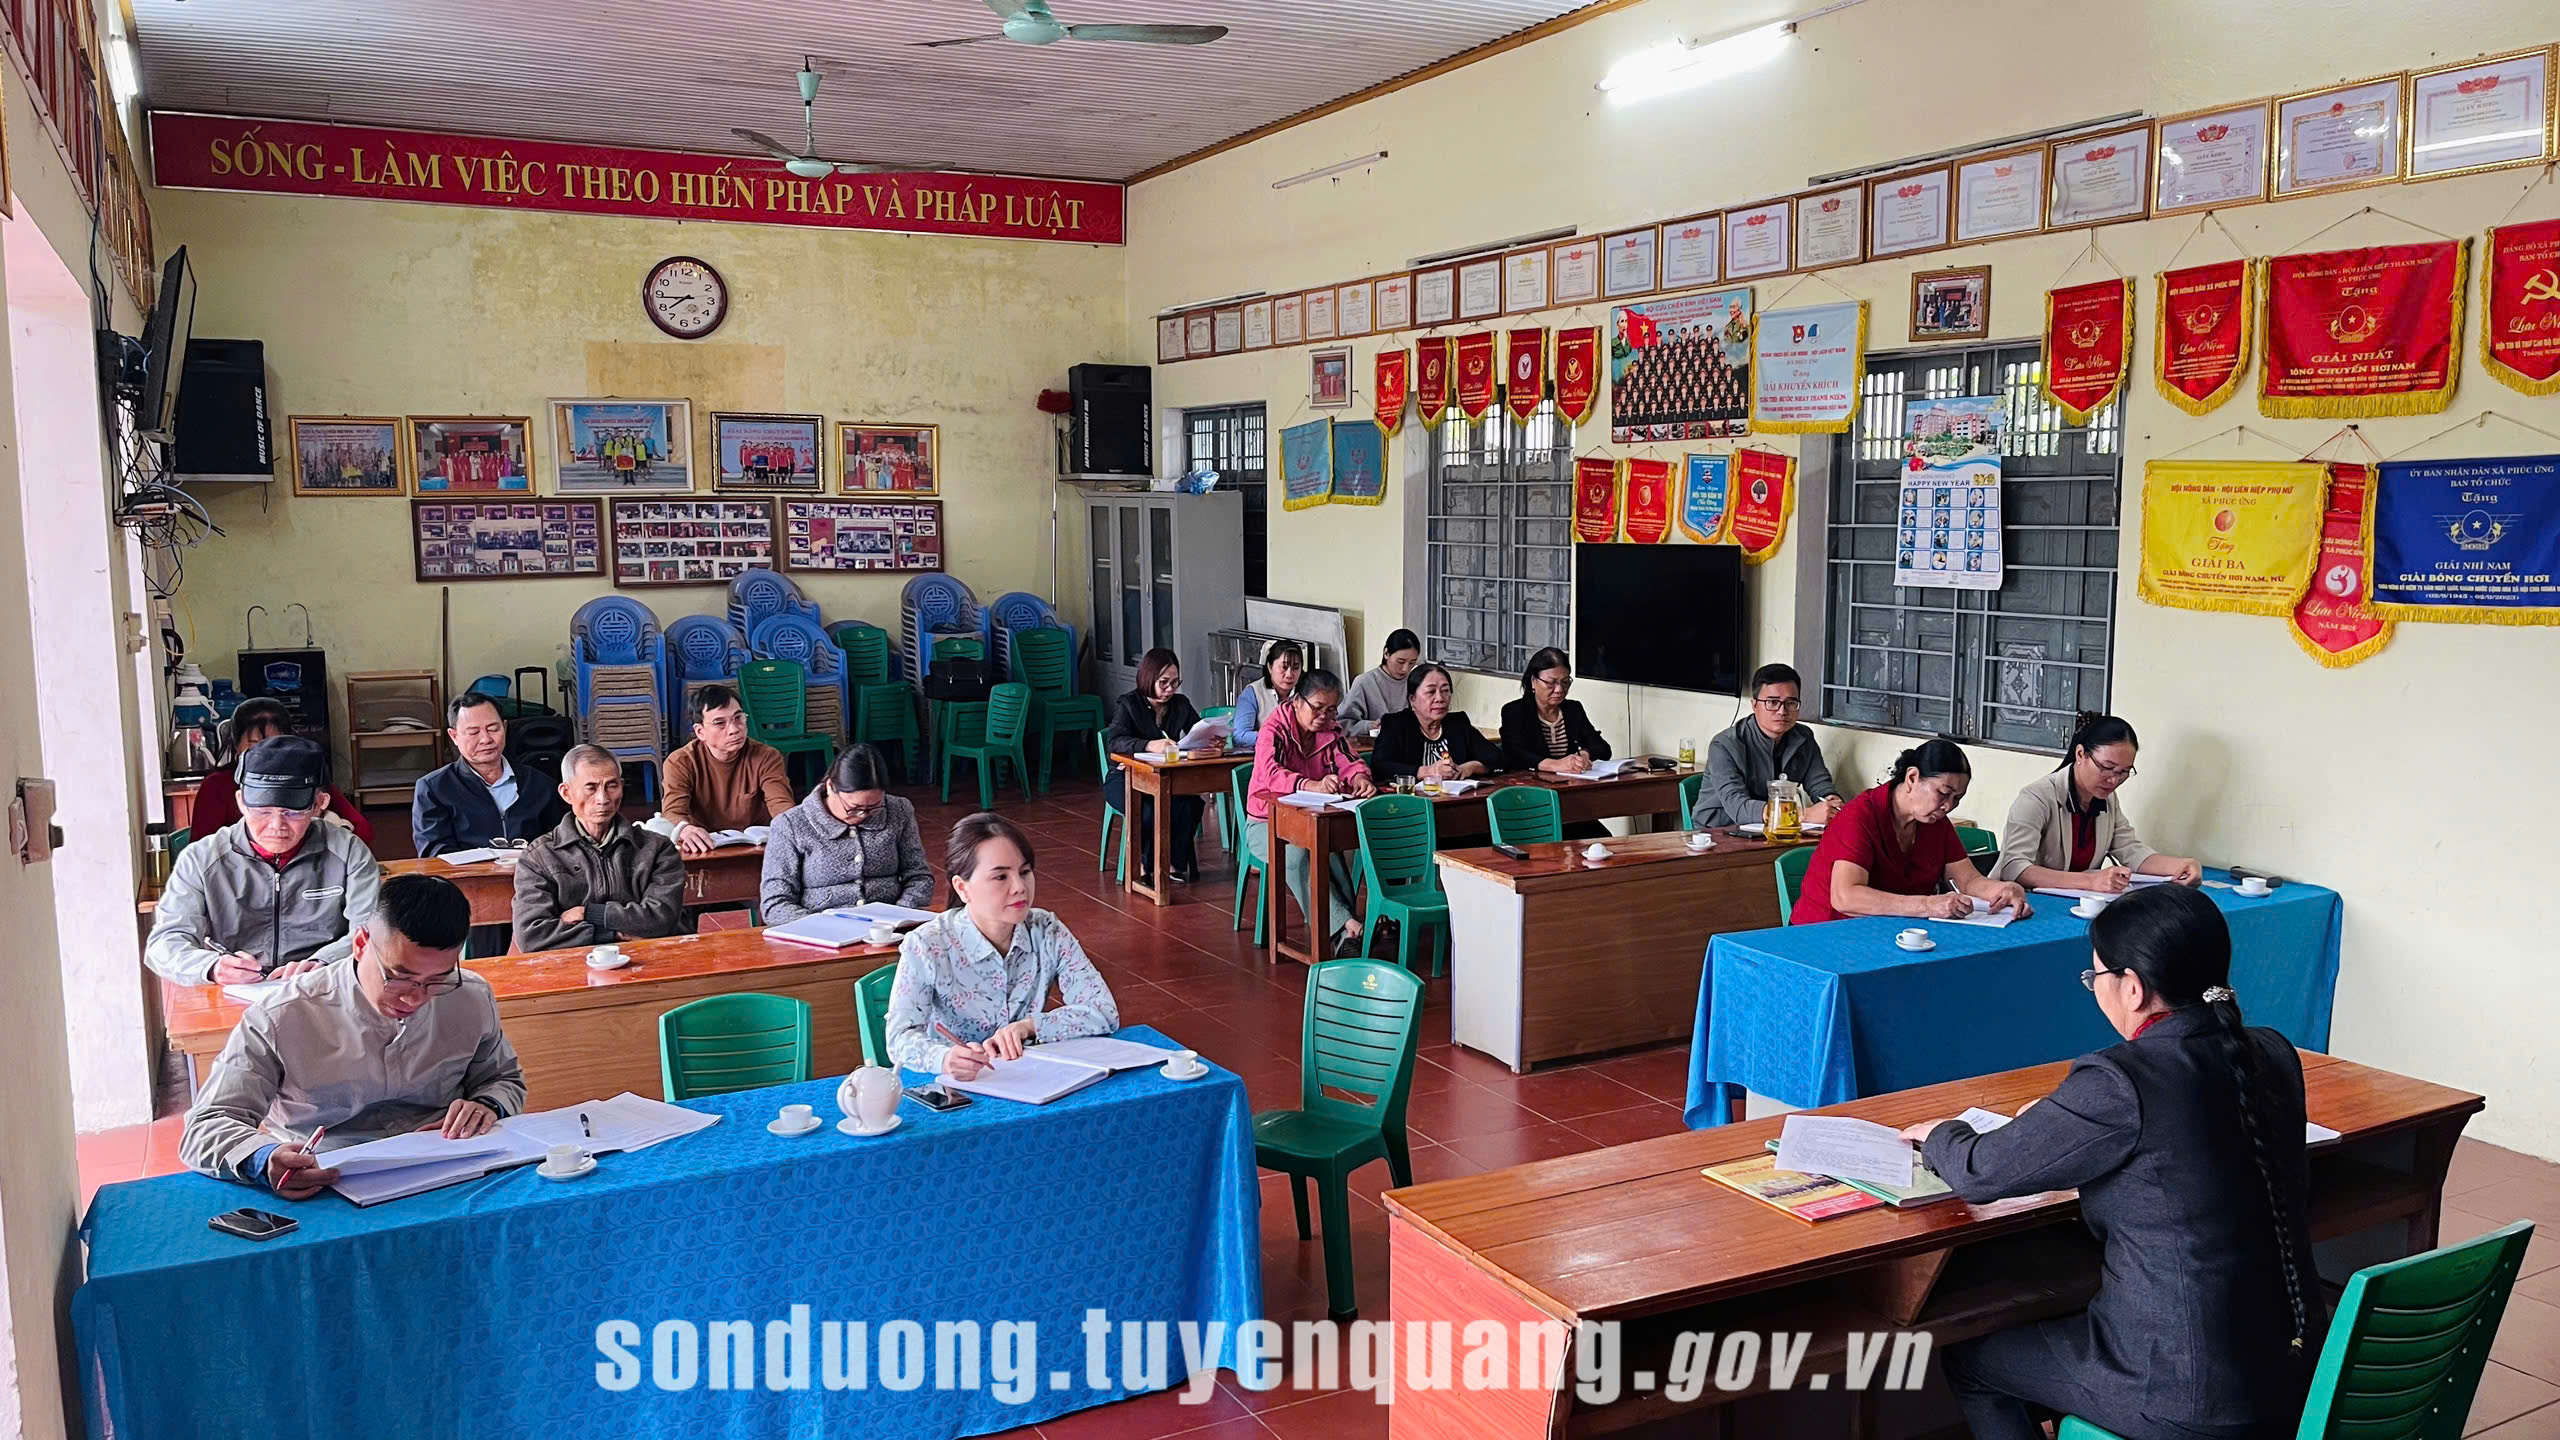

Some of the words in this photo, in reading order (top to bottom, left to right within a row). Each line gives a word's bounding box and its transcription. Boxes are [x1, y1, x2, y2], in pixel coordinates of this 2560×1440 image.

[210, 125, 325, 181] SỐNG
[351, 139, 443, 189] LÀM
[453, 150, 548, 203] VIỆC
[556, 164, 660, 205] THEO
[670, 162, 756, 211] HIẾN
[766, 176, 854, 217] PHÁP
[862, 178, 907, 220] VÀ
[915, 183, 998, 225] PHÁP
[1005, 190, 1085, 236] LUẬT
[2519, 253, 2535, 262] BAN
[681, 268, 692, 276] 12
[655, 290, 664, 298] 9
[705, 284, 712, 292] 2
[707, 297, 715, 305] 3
[2311, 352, 2347, 364] GIẢI
[2352, 347, 2394, 361] NHẤT
[1778, 379, 1811, 391] KHUYẾN
[1813, 380, 1839, 389] KHÍCH
[255, 386, 264, 420] DANCE
[256, 420, 265, 433] OF
[258, 434, 267, 464] MUSIC
[2410, 468, 2421, 478] ỦY
[2424, 469, 2442, 477] BAN
[2444, 468, 2469, 476] NHÂN
[2472, 467, 2490, 476] DÂN
[2492, 466, 2504, 475] XÃ
[2508, 465, 2532, 474] PHÚC
[2535, 465, 2554, 474] ỨNG
[2451, 479, 2468, 488] BAN
[2470, 478, 2482, 487] TỔ
[2484, 478, 2511, 486] CHỨC
[2171, 485, 2181, 493] HỘI
[2183, 484, 2201, 493] NÔNG
[2202, 485, 2216, 494] DÂN
[2222, 486, 2233, 494] HỘI
[2234, 486, 2249, 494] LIÊN
[2250, 486, 2265, 495] HIỆP
[2267, 487, 2281, 496] PHỤ
[2282, 485, 2293, 495] NỮ
[2201, 496, 2212, 505] XÃ
[2462, 492, 2498, 504] Tặng
[2208, 536, 2235, 554] Tặng
[2191, 555, 2222, 569] GIẢI
[2226, 560, 2245, 570] BA
[2435, 560, 2459, 570] GIẢI
[2487, 561, 2511, 569] NAM
[2400, 571, 2425, 582] GIẢI
[2429, 572, 2463, 582] BÓNG
[2467, 572, 2520, 583] CHUYỀN
[2524, 574, 2550, 582] HƠI
[2303, 600, 2334, 617] Lưu
[2318, 621, 2338, 630] NĂM
